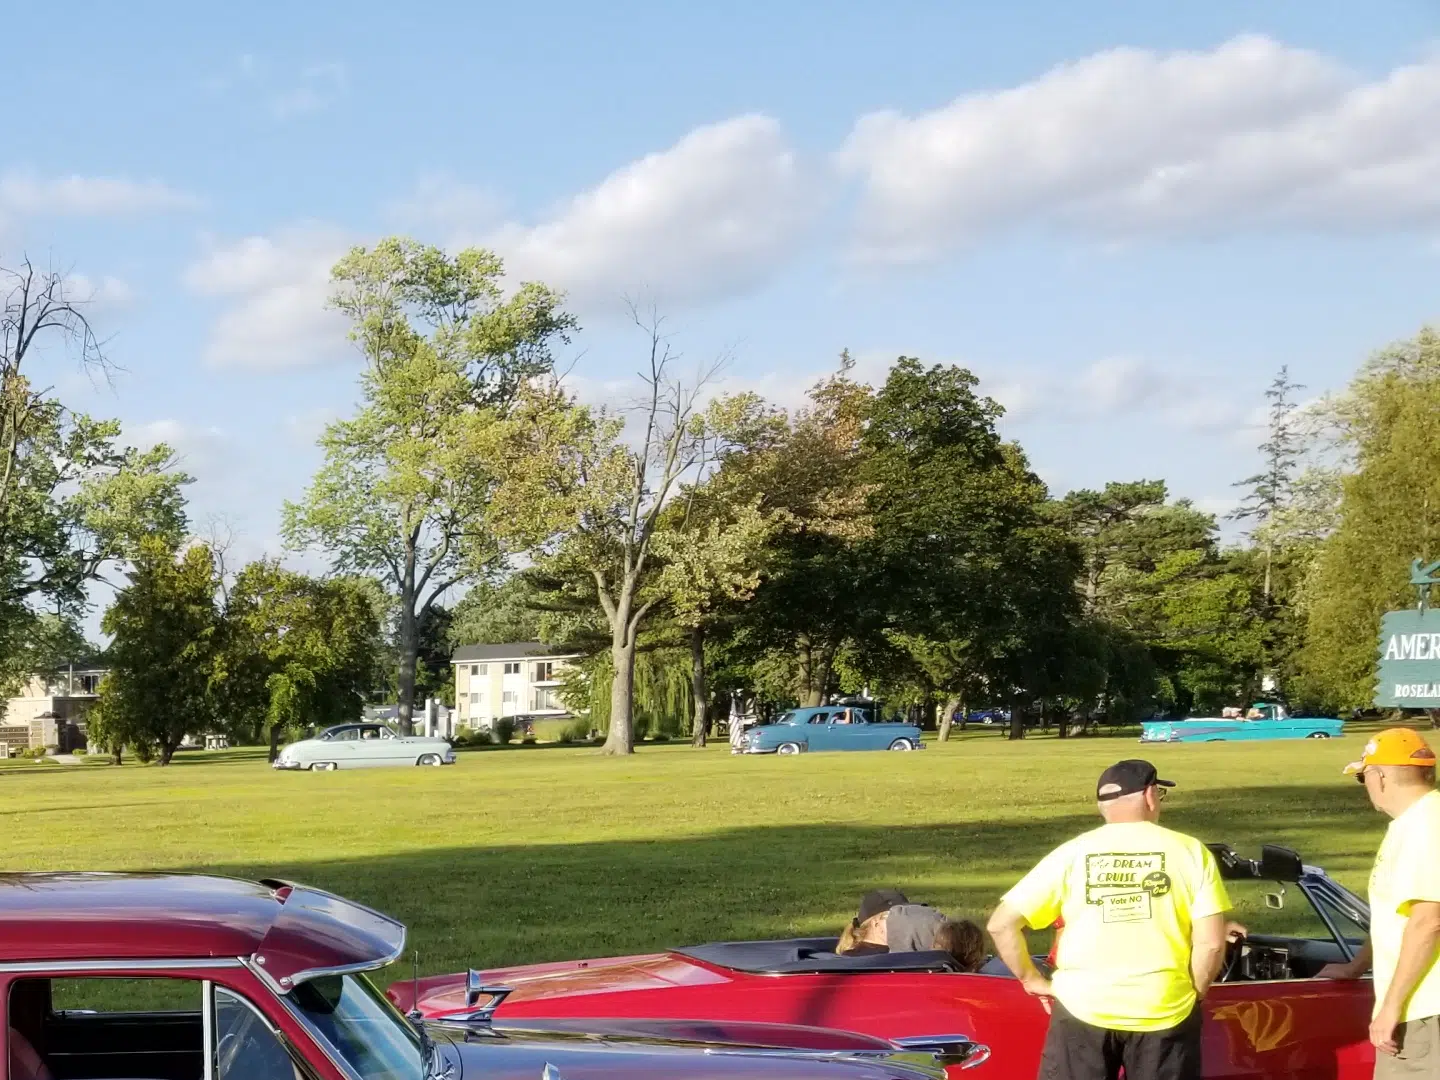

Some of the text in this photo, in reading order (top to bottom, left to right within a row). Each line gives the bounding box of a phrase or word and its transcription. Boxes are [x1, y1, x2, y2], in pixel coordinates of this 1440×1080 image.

[1395, 684, 1440, 699] ROSELA
[1113, 859, 1152, 869] DREAM
[1097, 872, 1137, 883] CRUISE
[1152, 886, 1168, 895] Oak
[1110, 895, 1142, 906] Vote NO
